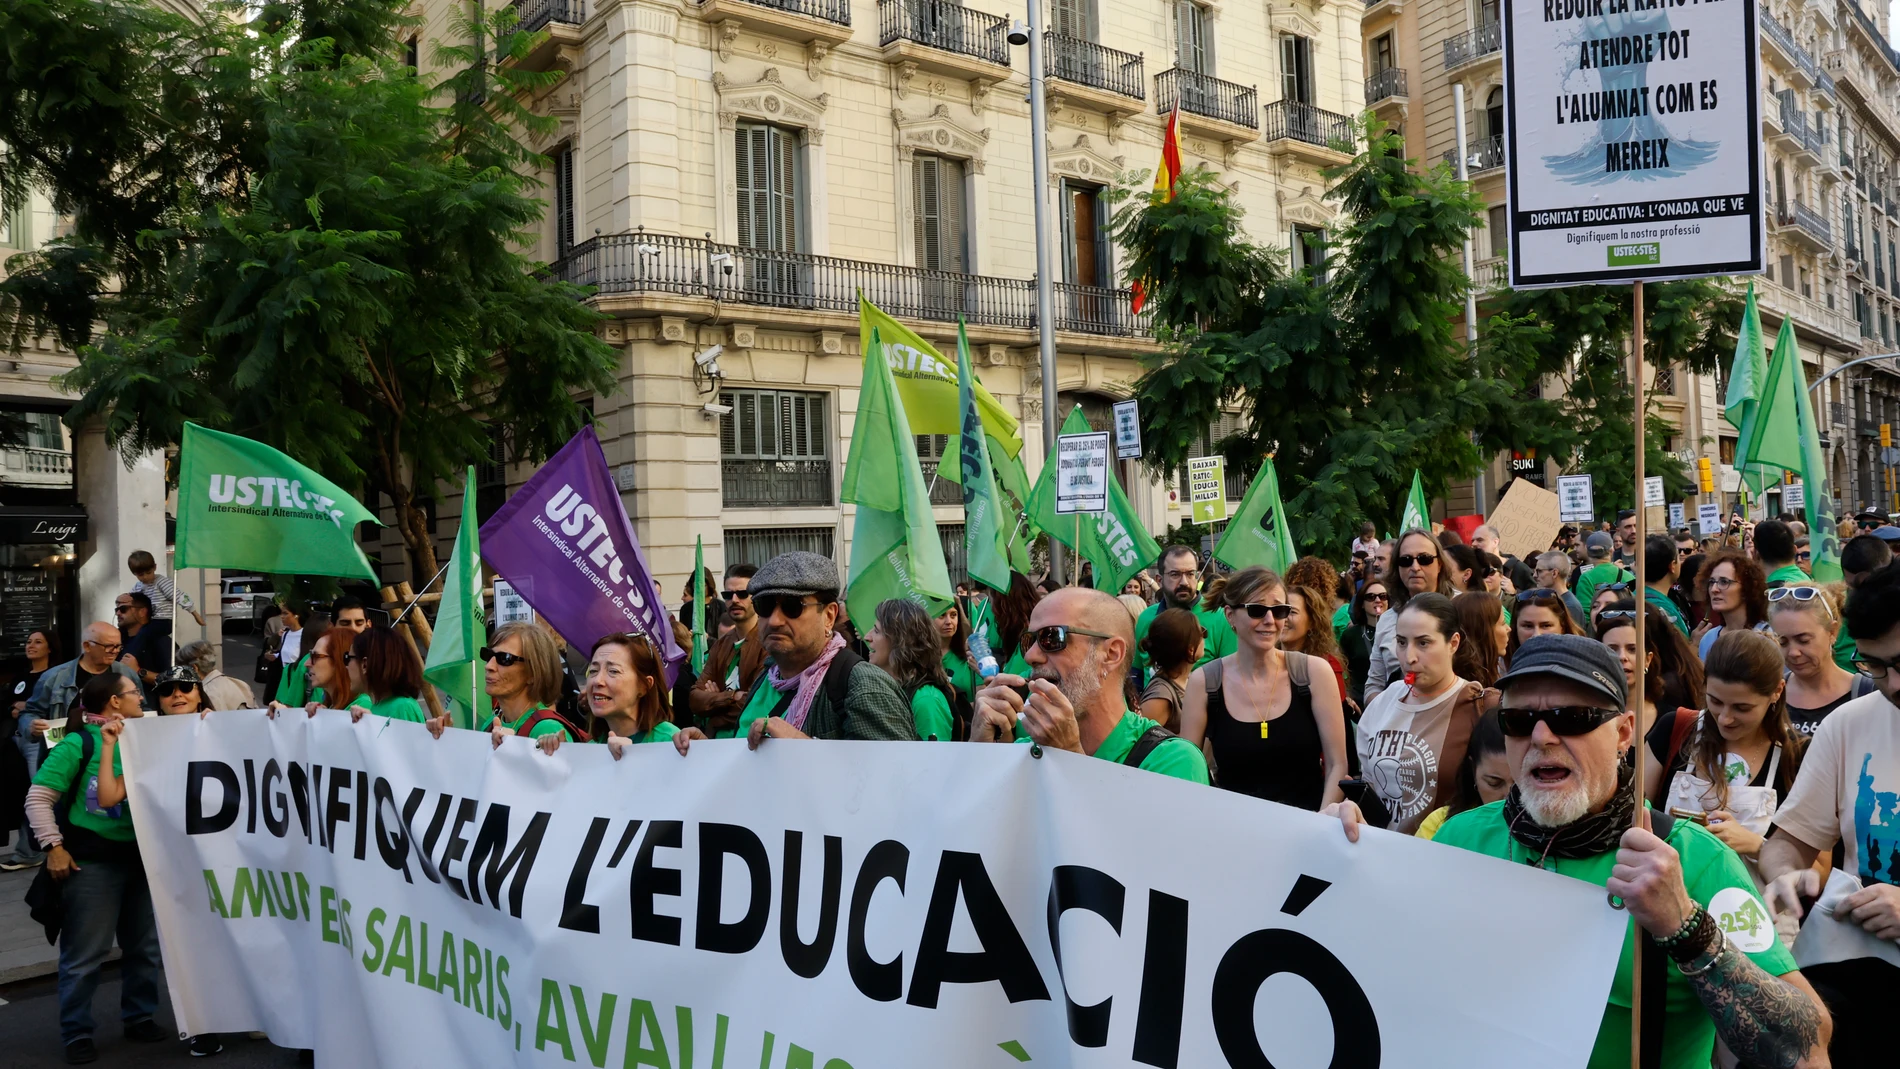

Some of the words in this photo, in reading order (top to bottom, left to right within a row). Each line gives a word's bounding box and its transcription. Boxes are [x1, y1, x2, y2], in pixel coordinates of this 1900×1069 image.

[1579, 34, 1653, 70] ATENDRE
[1657, 29, 1690, 61] TOT
[1556, 86, 1649, 124] L'ALUMNAT
[1655, 82, 1694, 115] COM
[1700, 79, 1718, 111] ES
[1605, 138, 1670, 173] MEREIX
[1530, 209, 1580, 227] DIGNITAT
[1582, 204, 1645, 222] EDUCATIVA:
[1703, 198, 1726, 215] QUE
[1730, 197, 1744, 211] VE
[1567, 228, 1618, 245] Dignifiquem
[1620, 229, 1629, 240] la
[1630, 227, 1658, 239] nostra
[1660, 224, 1700, 239] professió
[913, 371, 954, 385] Alternativa
[1192, 460, 1217, 469] BAIXAR
[1513, 458, 1534, 470] SUKI
[1194, 481, 1218, 490] EDUCAR
[1195, 492, 1218, 500] MILLOR
[208, 504, 269, 517] Intersindical
[272, 508, 314, 519] Alternativa
[314, 513, 323, 521] de
[32, 520, 78, 541] Luigi
[1520, 525, 1553, 552] FER
[531, 513, 574, 559] Intersindical
[572, 550, 614, 599] Alternativa
[611, 596, 624, 608] de
[185, 758, 552, 920] DIGNIFIQUEM
[558, 816, 1382, 1069] L'EDUCACIÓ
[361, 906, 521, 1052] SALARIS,
